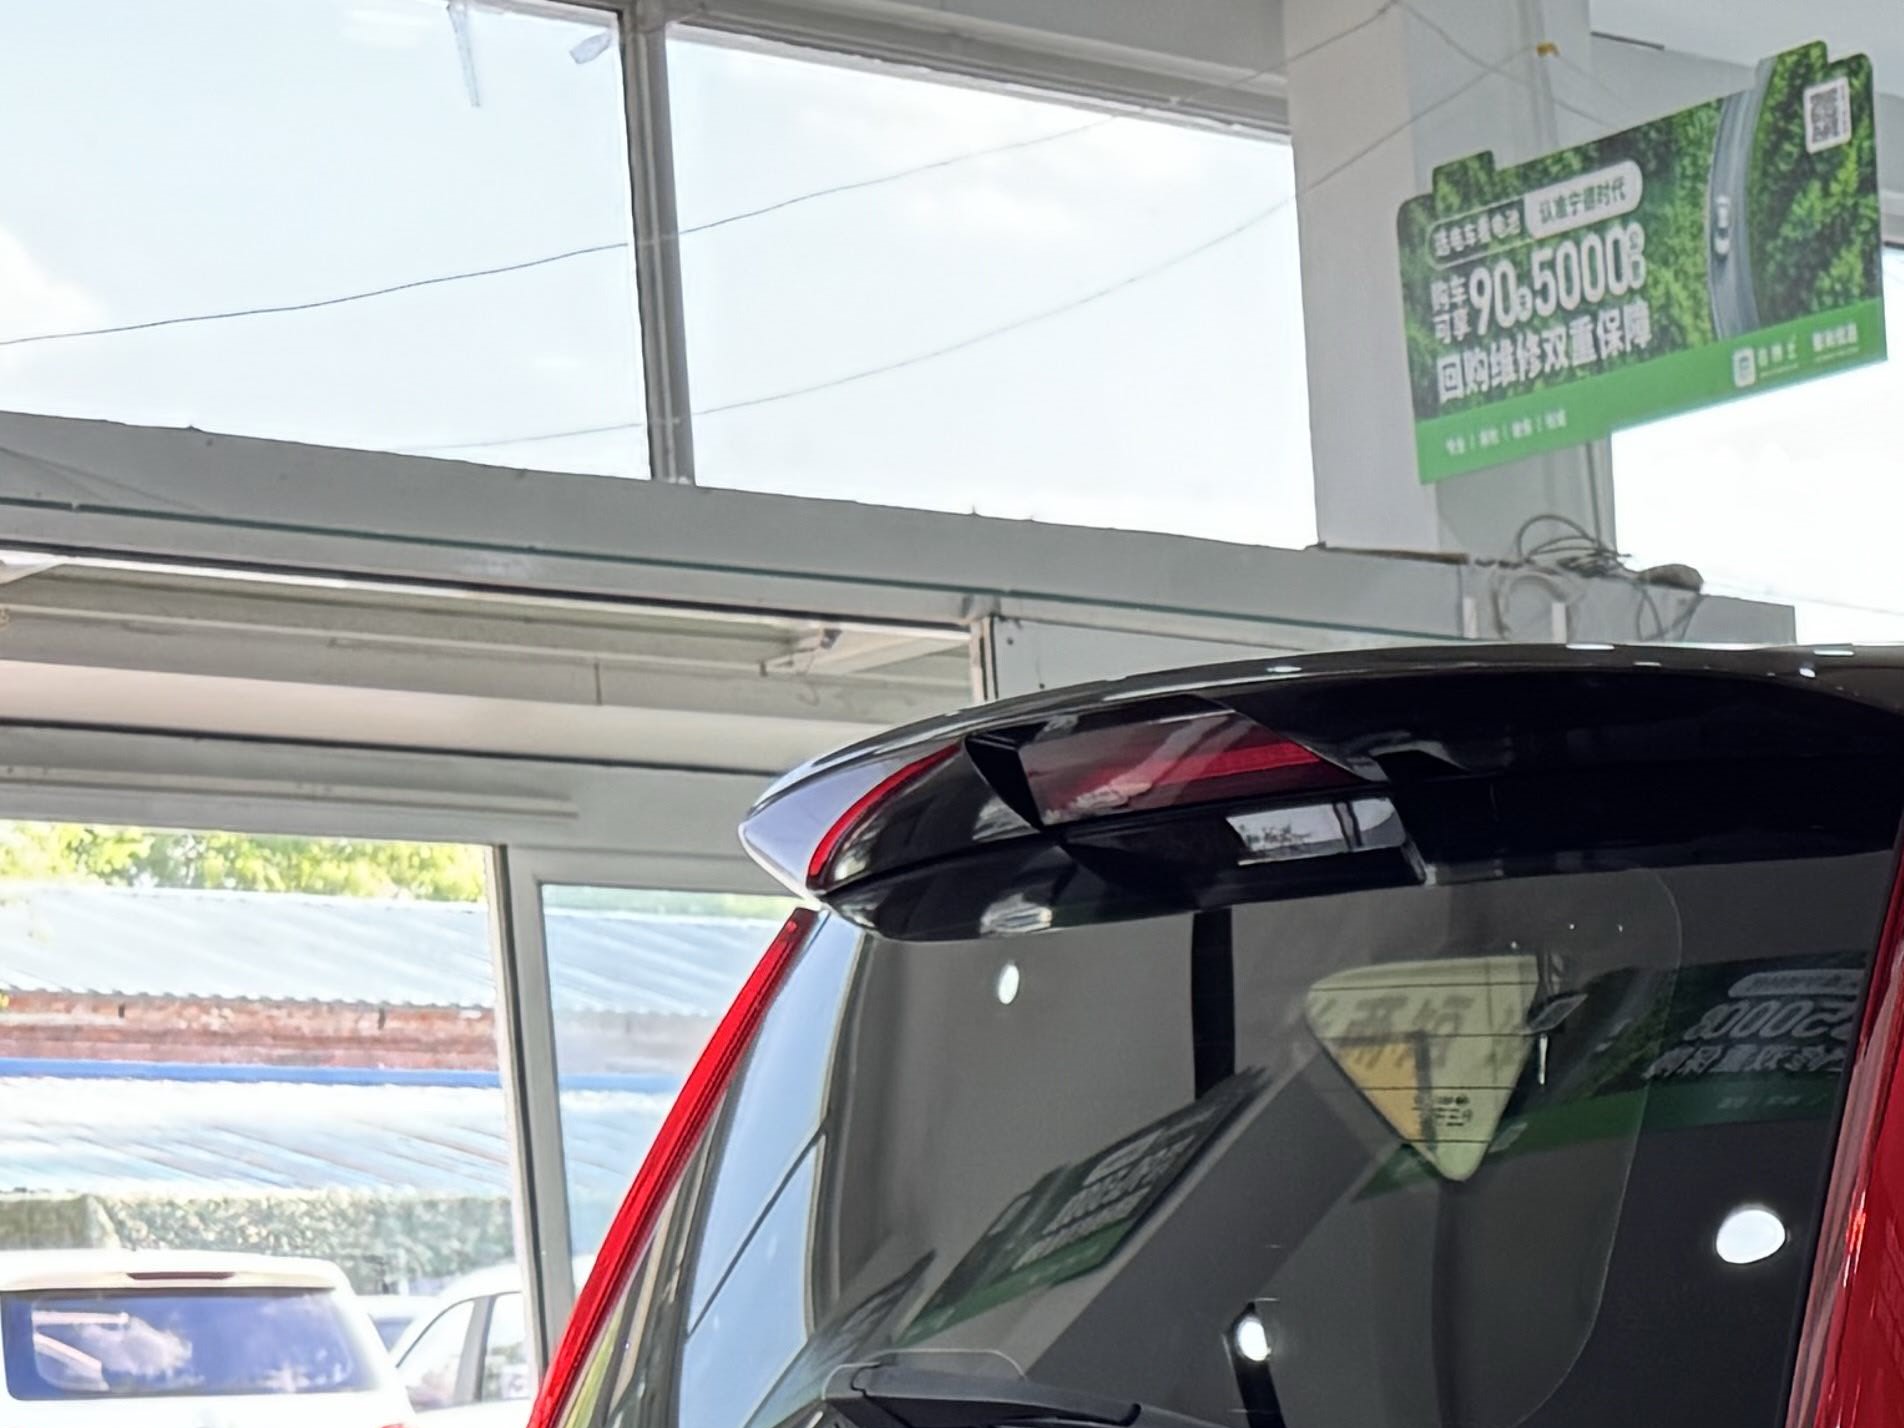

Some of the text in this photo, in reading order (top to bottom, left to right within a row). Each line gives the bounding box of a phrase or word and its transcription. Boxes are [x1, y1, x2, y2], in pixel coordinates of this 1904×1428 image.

[1436, 295, 1652, 405] 回购维修双重保障
